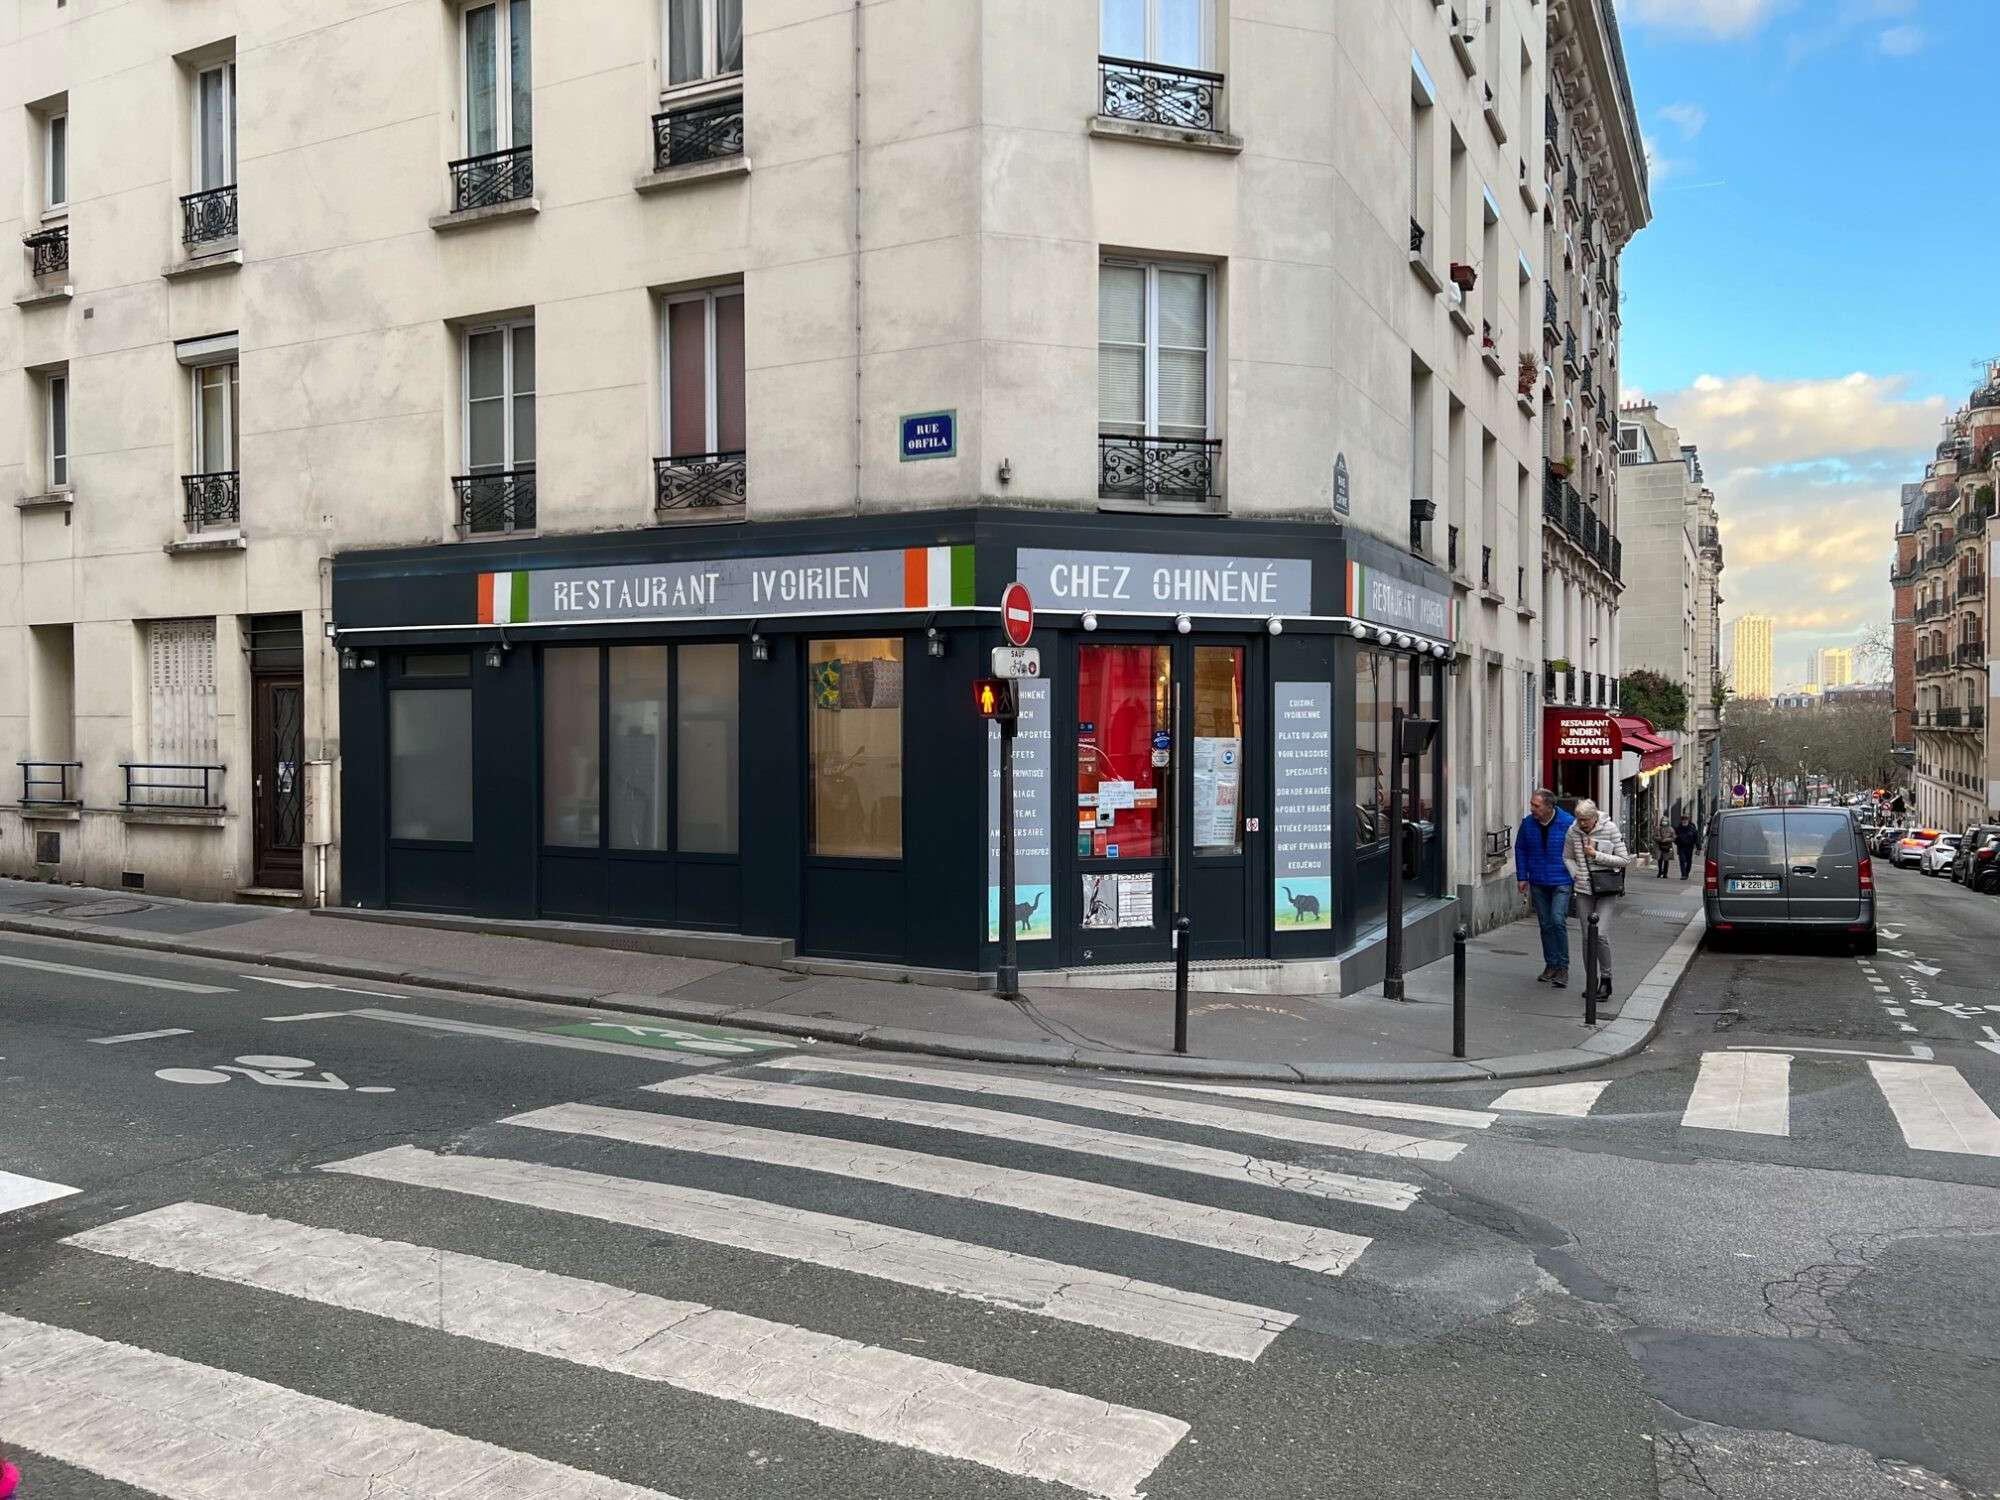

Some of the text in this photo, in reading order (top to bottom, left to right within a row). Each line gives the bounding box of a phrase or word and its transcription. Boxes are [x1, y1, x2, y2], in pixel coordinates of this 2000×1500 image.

[916, 423, 939, 435] RUE
[908, 437, 948, 449] ORFILA
[1050, 561, 1278, 603] CHEZ OHINÉNÉ
[553, 565, 869, 611] RESTAURANT IVOIRIEN
[1372, 581, 1416, 620] RESTAURANT
[1011, 650, 1025, 658] SAUF
[1019, 690, 1046, 700] HINÉNÉ
[1278, 731, 1300, 741] PLATS
[1569, 728, 1601, 737] INDIEN
[1560, 737, 1610, 747] NEELKANTH
[1278, 750, 1294, 759] VOIR
[1568, 747, 1578, 755] 43
[1580, 747, 1590, 755] 49
[1591, 747, 1601, 755] 06
[1303, 823, 1332, 833] POISSON
